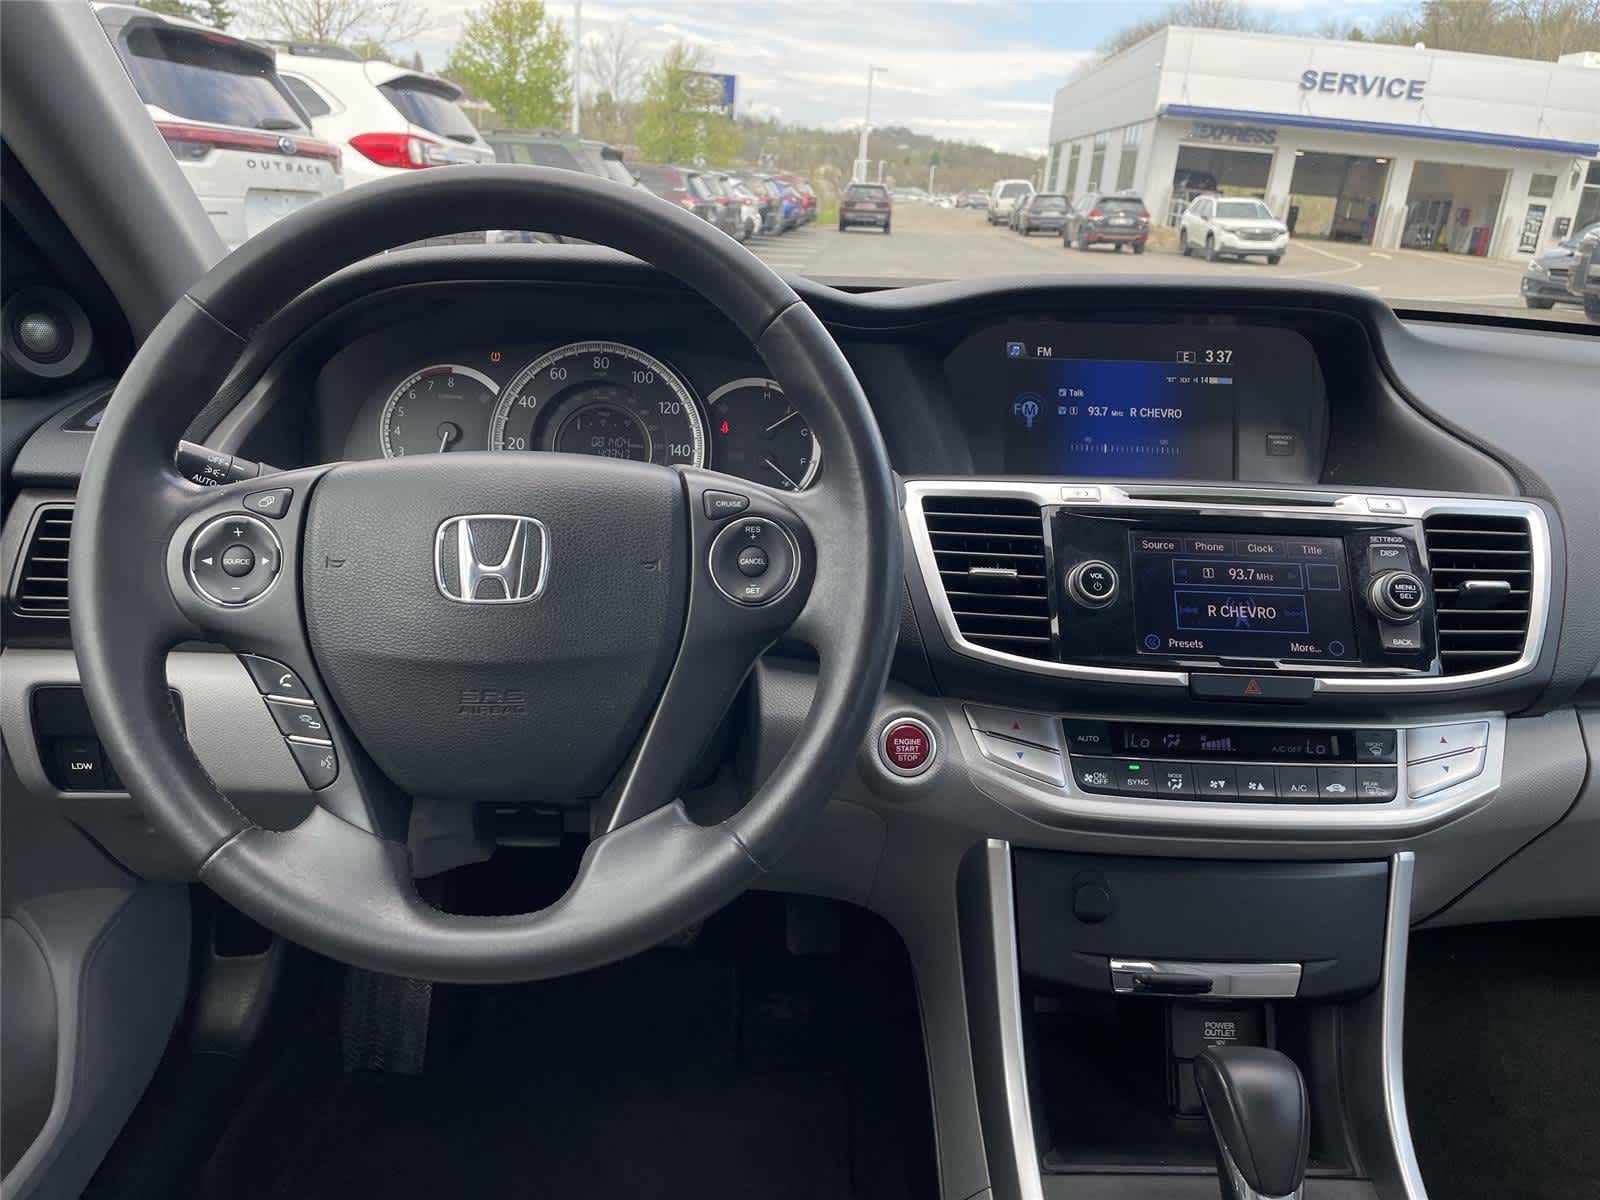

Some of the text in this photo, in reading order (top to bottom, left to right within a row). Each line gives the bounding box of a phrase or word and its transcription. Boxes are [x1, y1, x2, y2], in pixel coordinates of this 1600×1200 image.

[1300, 69, 1426, 101] SERVICE
[247, 160, 321, 174] OUTBACK
[1037, 346, 1052, 357] FM
[592, 356, 610, 370] 80
[550, 367, 567, 381] 60
[631, 370, 654, 385] 100
[428, 380, 434, 391] 7
[447, 376, 455, 388] 8
[408, 389, 417, 400] 6
[1068, 388, 1084, 397] Talk
[518, 395, 537, 409] 40
[397, 406, 404, 417] 5
[657, 401, 681, 415] 120
[1087, 406, 1109, 417] 93.7
[1130, 407, 1137, 417] R
[1140, 408, 1182, 419] CHEVRO
[507, 436, 525, 450] 20
[668, 443, 691, 457] 140
[192, 474, 217, 487] AUTO
[715, 500, 742, 508] CRUISE
[745, 525, 761, 533] RES
[1142, 540, 1175, 550] Source
[1195, 542, 1225, 552] Phone
[1247, 543, 1274, 554] Clock
[1303, 545, 1323, 555] Title
[1380, 549, 1400, 557] DISP
[223, 557, 251, 566] SOURCE
[1090, 572, 1104, 580] VOL
[1228, 567, 1255, 581] 93.7
[1256, 572, 1274, 582] MHz
[745, 587, 761, 595] SET
[1394, 583, 1417, 592] MENU
[1399, 592, 1414, 600] SEL
[1207, 604, 1217, 617] R
[1219, 604, 1277, 620] CHEVRO
[1168, 638, 1204, 649] Presets
[1392, 638, 1414, 646] BACK
[1077, 735, 1100, 743] AUTO
[897, 754, 918, 762] STOP
[71, 762, 93, 770] LDW
[1127, 778, 1149, 786] SYNC
[1291, 783, 1308, 792] A/C
[1204, 1021, 1235, 1029] POWER
[1204, 1029, 1236, 1037] OUTLET
